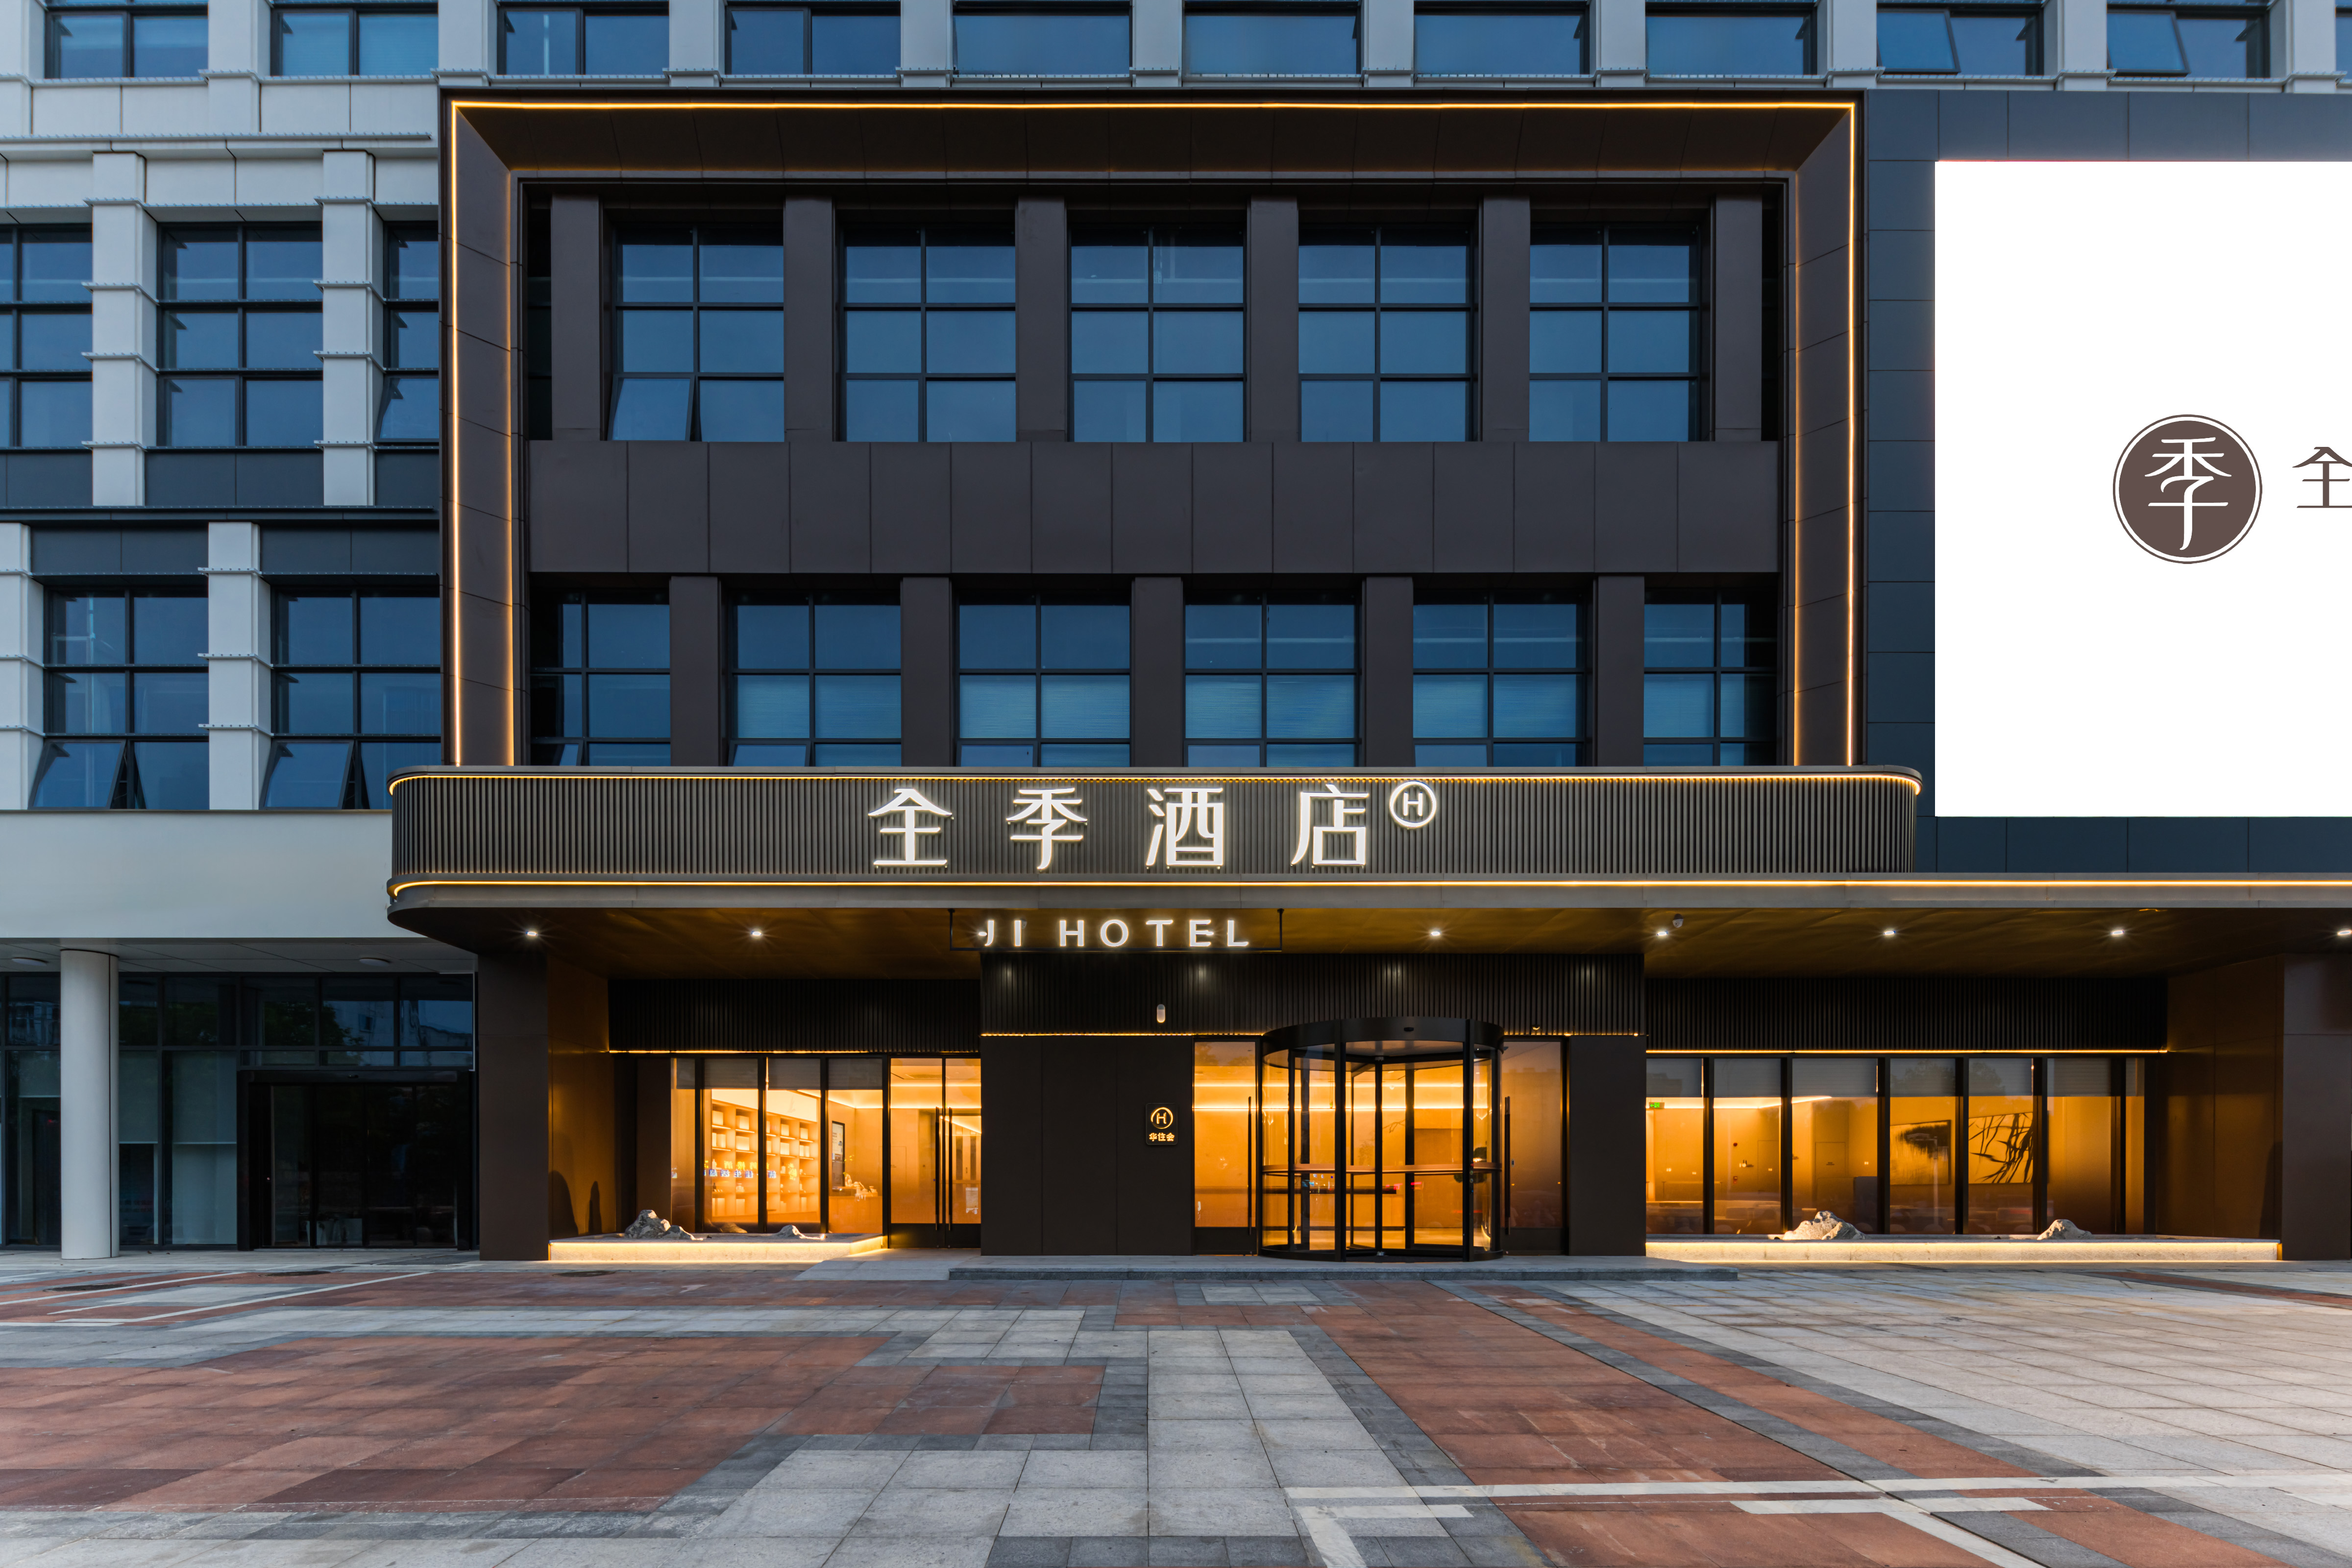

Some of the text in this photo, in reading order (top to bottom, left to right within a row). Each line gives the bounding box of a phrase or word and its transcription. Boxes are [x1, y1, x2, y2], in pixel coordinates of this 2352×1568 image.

[2144, 437, 2232, 551] 季
[2292, 446, 2352, 508] 全
[868, 784, 1370, 870] 全季酒店
[983, 919, 1249, 948] JI HOTEL
[1149, 1132, 1175, 1142] 华住会
